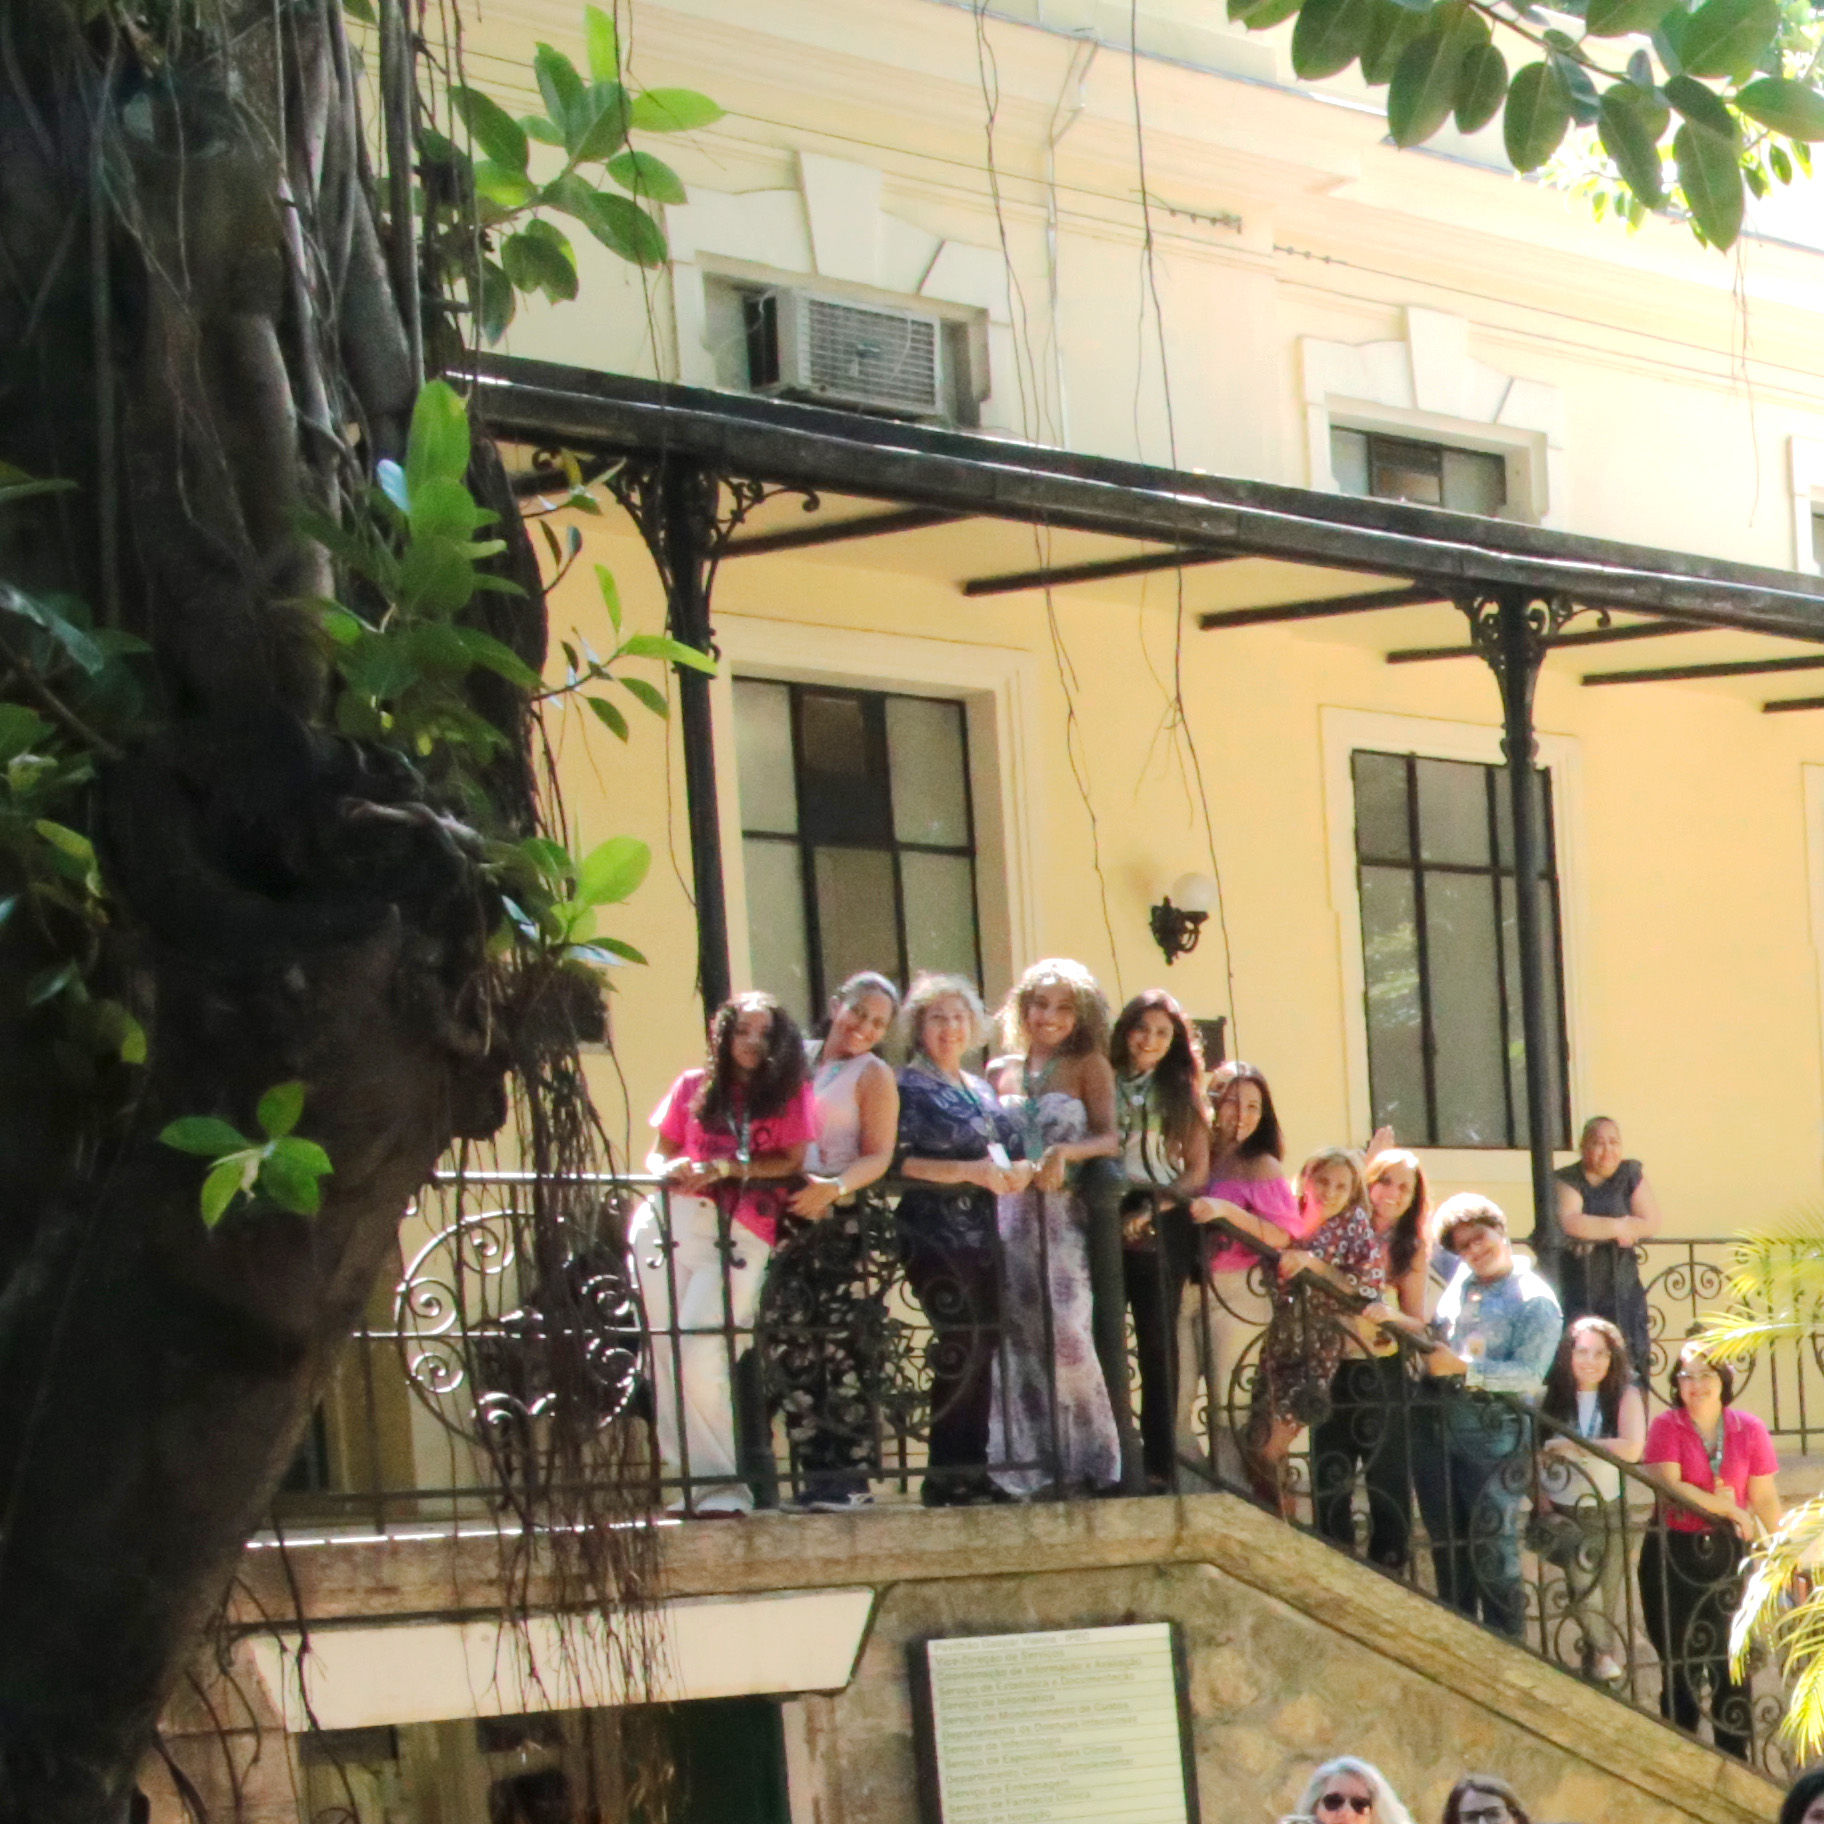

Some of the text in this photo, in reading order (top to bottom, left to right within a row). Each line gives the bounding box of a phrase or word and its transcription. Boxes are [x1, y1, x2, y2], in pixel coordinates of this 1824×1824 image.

[980, 1683, 992, 1692] de
[981, 1698, 994, 1707] de
[985, 1741, 997, 1750] de
[986, 1756, 999, 1764] de
[989, 1785, 1001, 1793] de
[990, 1800, 1002, 1808] de
[991, 1814, 1004, 1823] de
